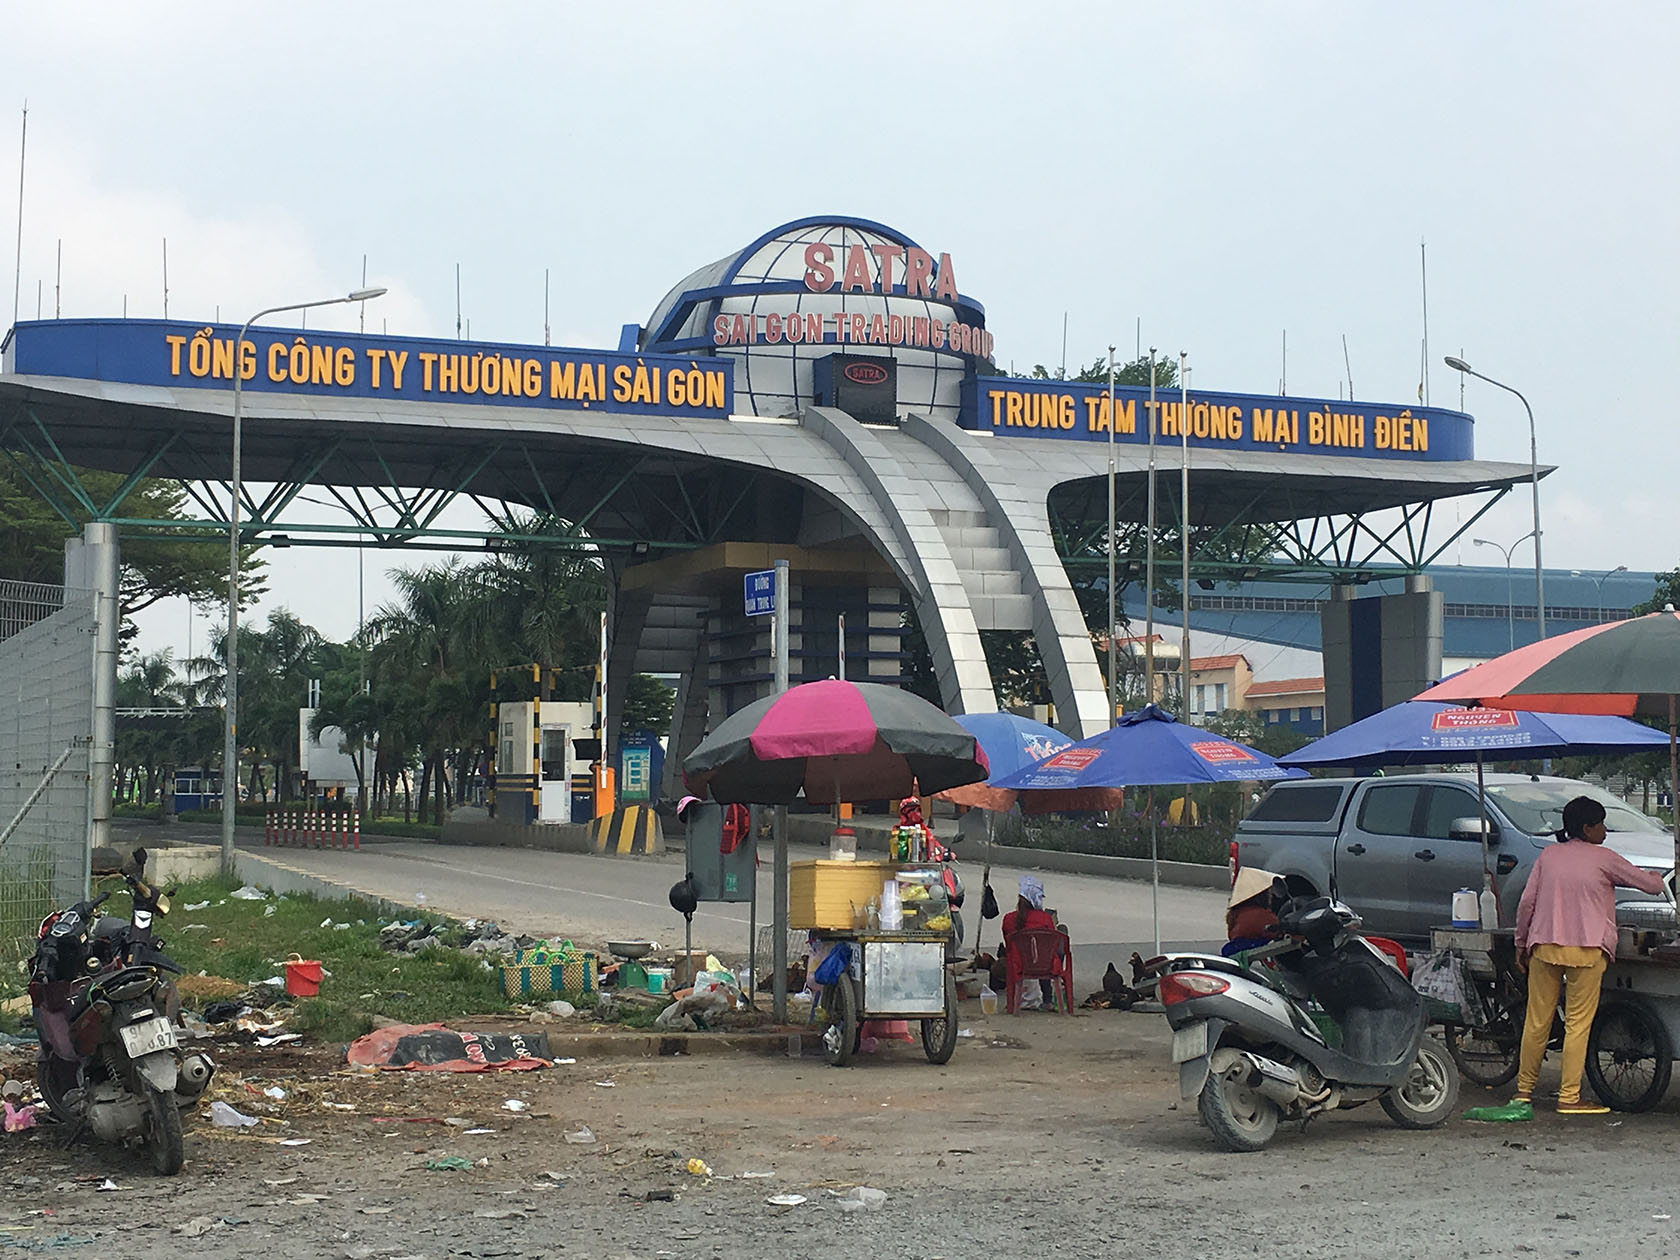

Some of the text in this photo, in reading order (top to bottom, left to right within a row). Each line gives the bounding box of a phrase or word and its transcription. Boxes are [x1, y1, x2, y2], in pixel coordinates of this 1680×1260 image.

[804, 242, 959, 301] SATRA
[765, 312, 823, 345] GON
[832, 312, 944, 349] TRADING
[166, 327, 725, 408] TỔNG CÔNG TY THƯƠNG MẠI SÀI GÒN
[988, 390, 1076, 430] TRUNG
[1084, 390, 1136, 434] TÂM
[1145, 400, 1243, 440] THƯƠNG
[1253, 408, 1299, 450] MẠI
[1309, 404, 1365, 448] BÌNH
